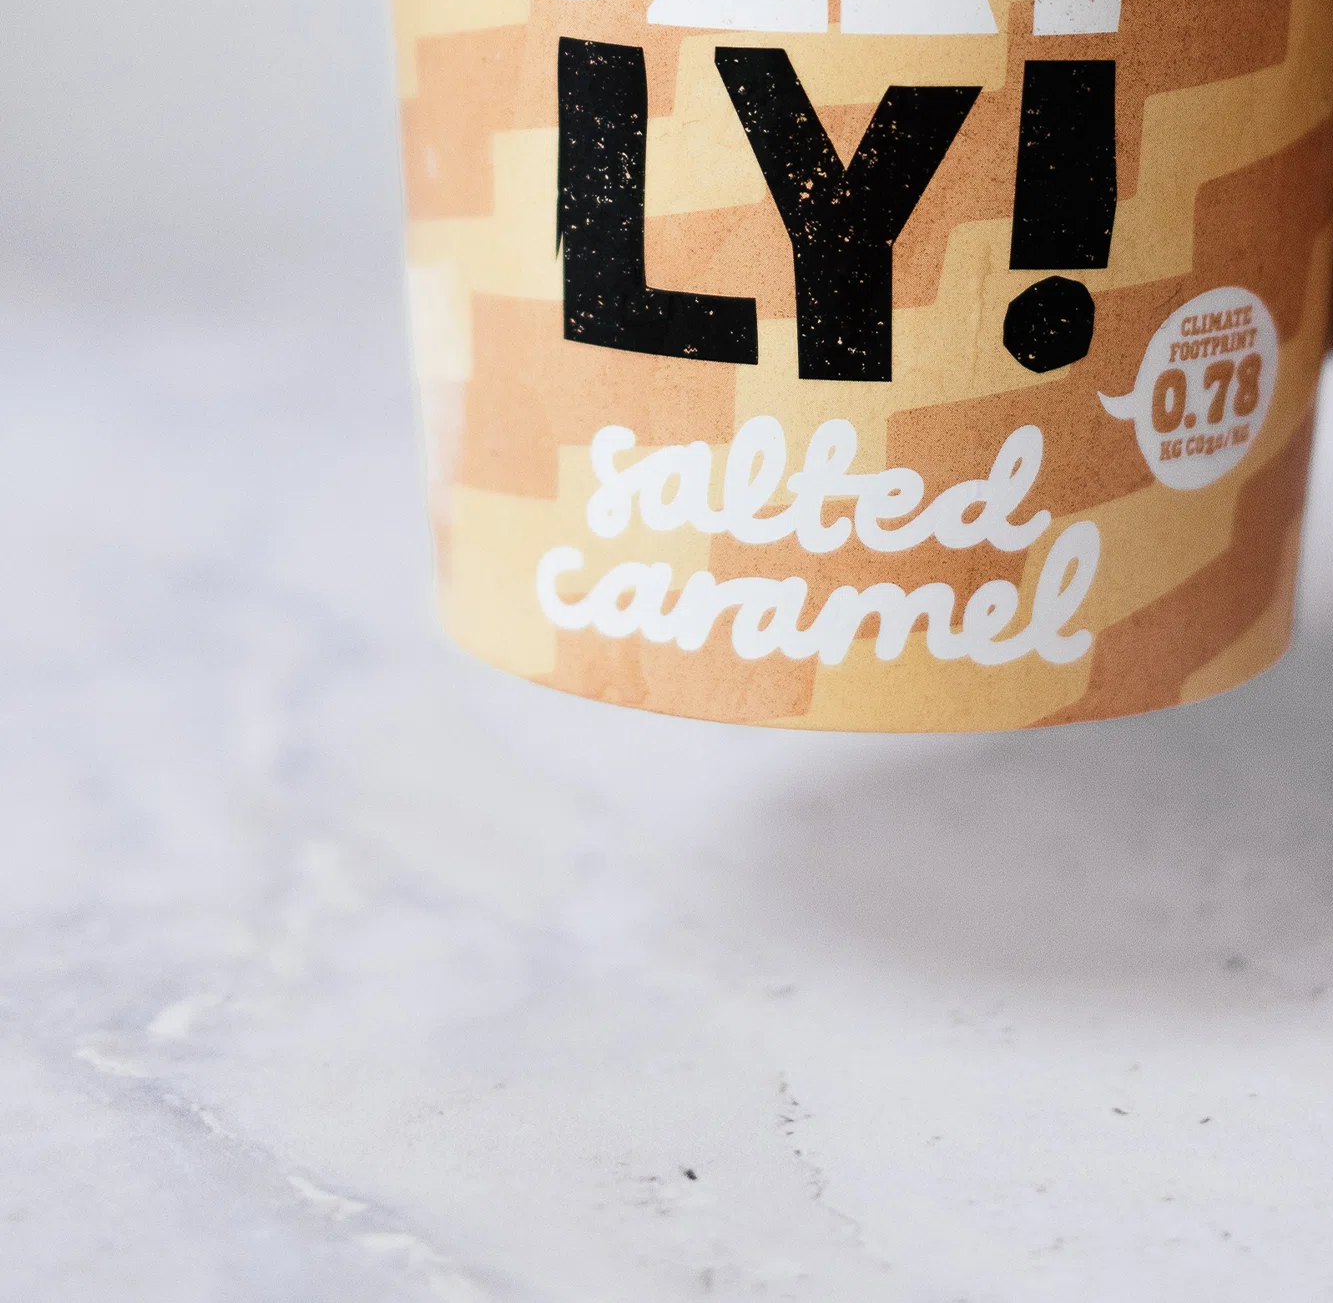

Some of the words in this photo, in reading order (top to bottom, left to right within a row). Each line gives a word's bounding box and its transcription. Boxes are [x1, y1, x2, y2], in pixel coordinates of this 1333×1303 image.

[555, 36, 1118, 383] LY!
[1169, 328, 1258, 363] FOOTPRINT
[1181, 304, 1253, 337] CLIMATE
[1151, 352, 1263, 434] 0.78
[586, 415, 1051, 553] salted
[536, 521, 1101, 666] caramel
